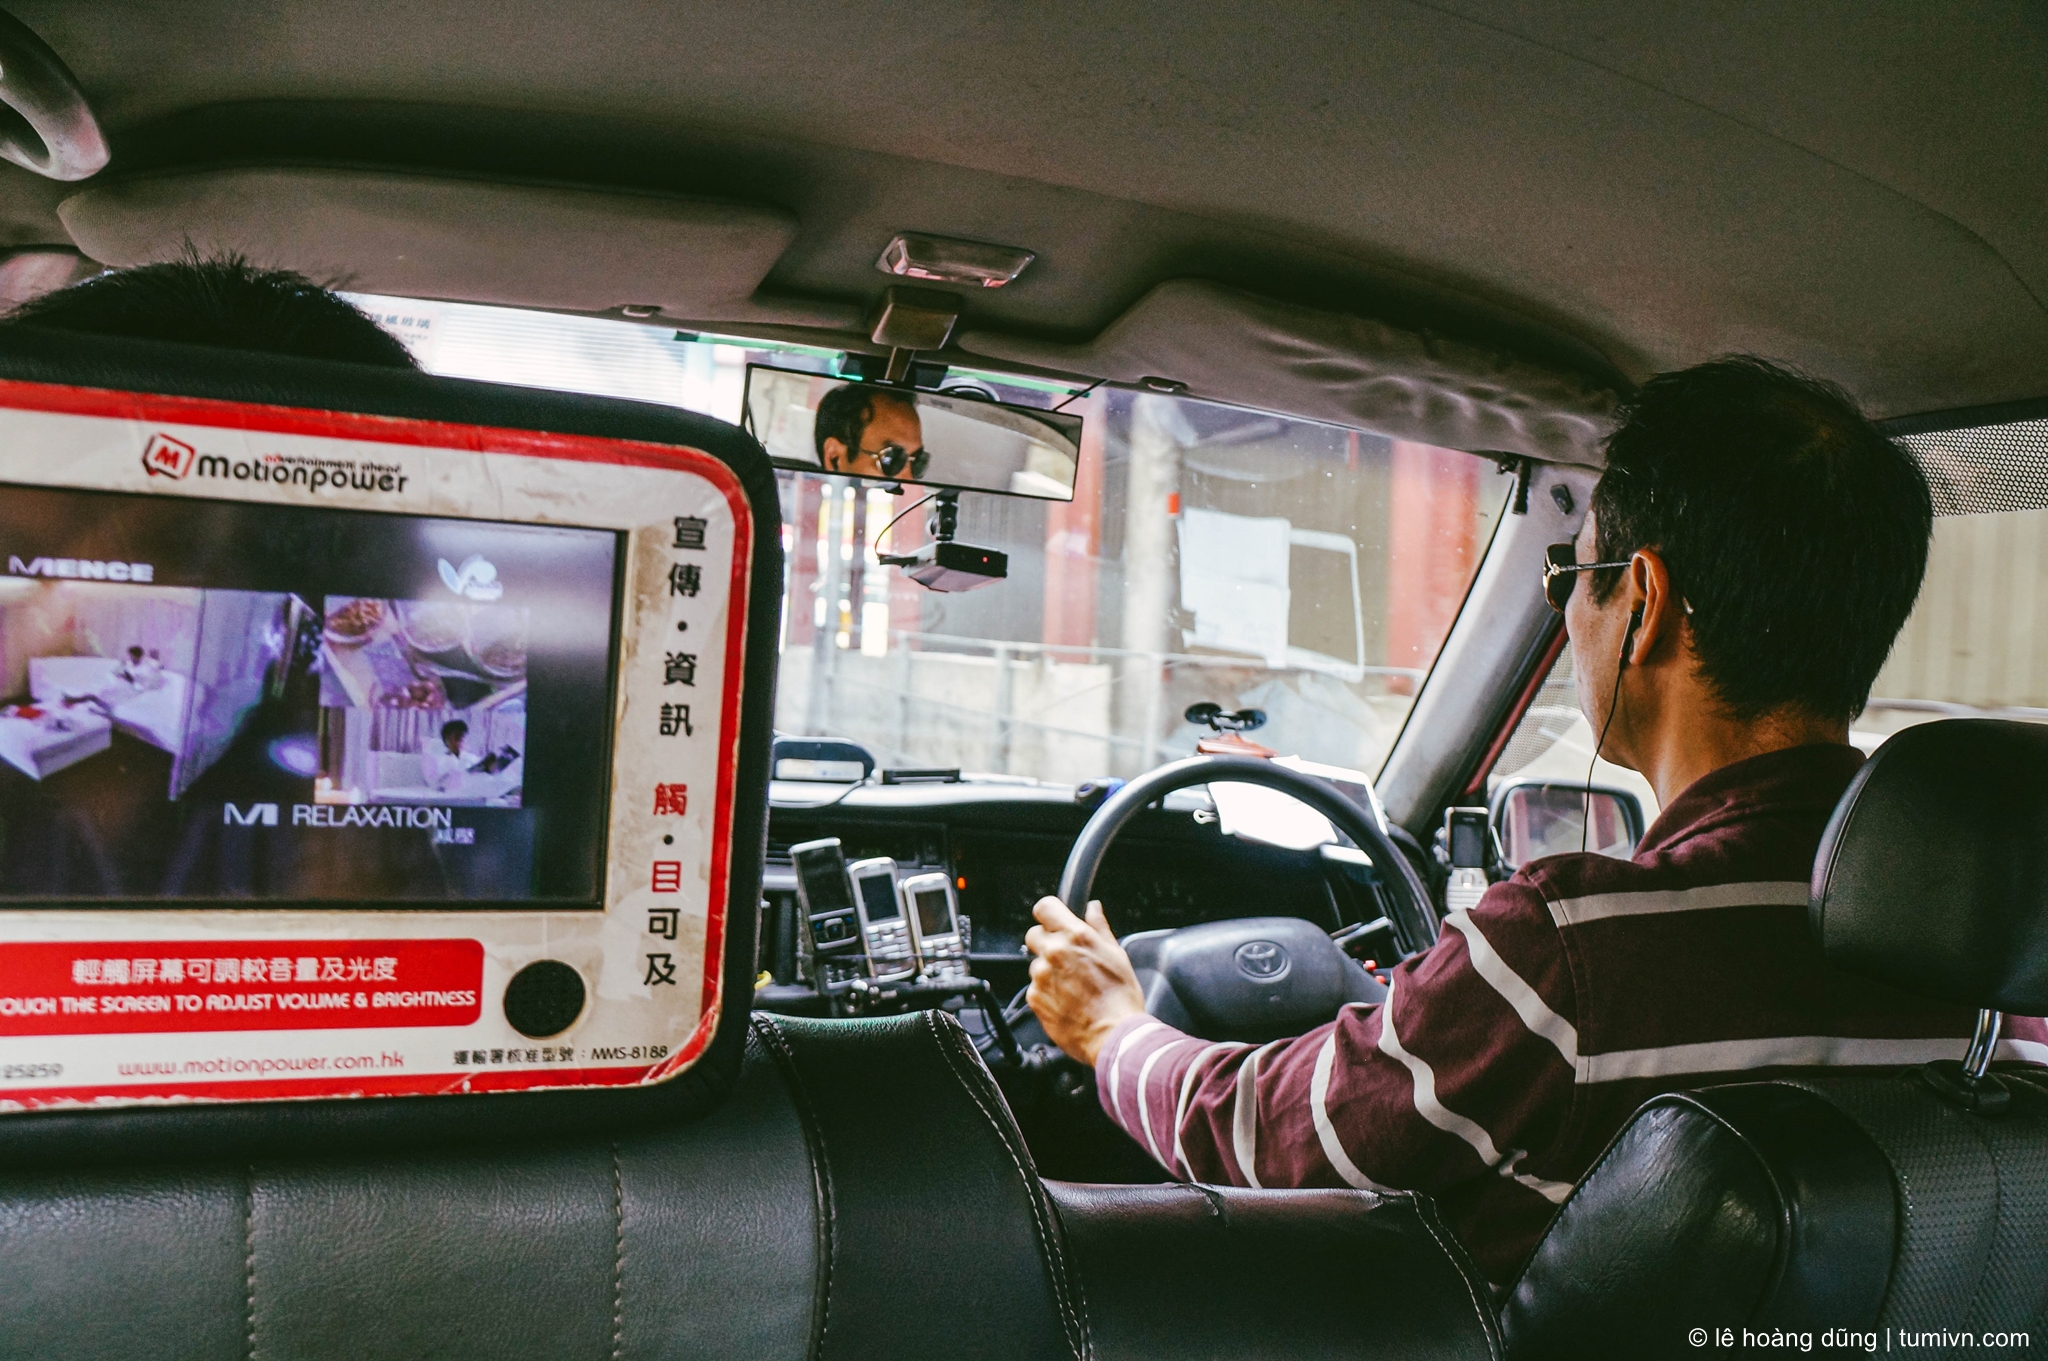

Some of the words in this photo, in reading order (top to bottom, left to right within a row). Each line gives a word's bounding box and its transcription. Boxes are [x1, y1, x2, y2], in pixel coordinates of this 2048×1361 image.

[197, 454, 409, 494] motionpower
[292, 804, 452, 828] RELAXATION
[72, 956, 398, 986] 輕觸屏幕可調較音量及光度
[0, 996, 58, 1017] OUCH
[59, 996, 99, 1014] THE
[100, 995, 171, 1014] SCREEN
[173, 994, 204, 1012] TO
[204, 993, 273, 1012] ADJUST
[276, 992, 351, 1010] VOLUME
[353, 991, 369, 1009] &
[371, 989, 477, 1008] BRIGHTNESS
[117, 1051, 405, 1077] www.motionpower.com.hk
[590, 1045, 668, 1061] MMS-8188
